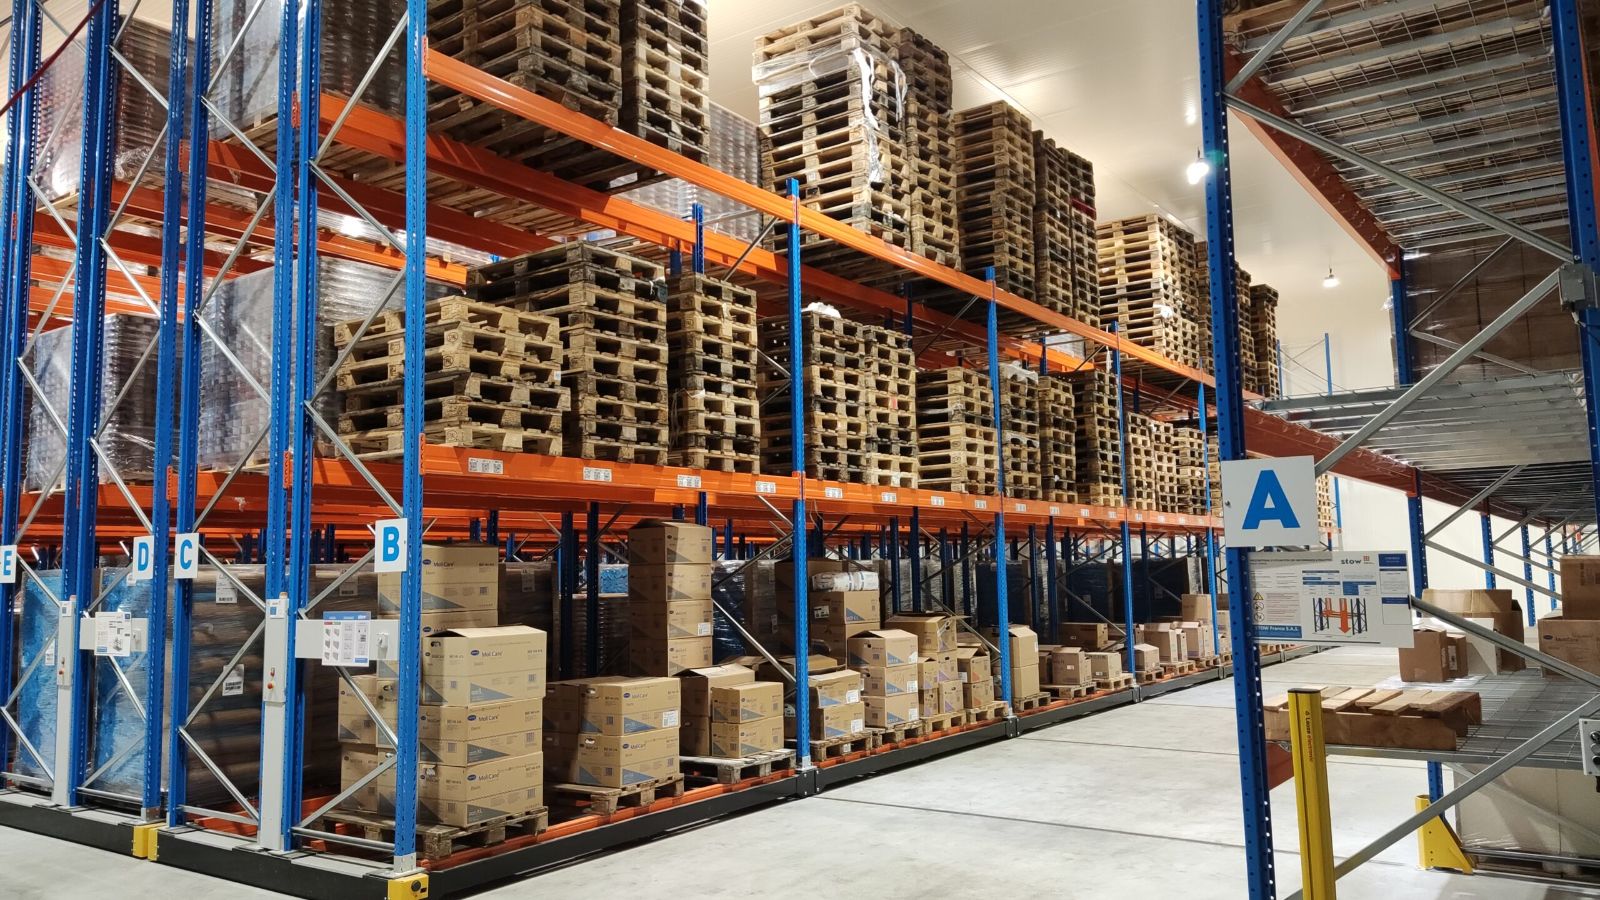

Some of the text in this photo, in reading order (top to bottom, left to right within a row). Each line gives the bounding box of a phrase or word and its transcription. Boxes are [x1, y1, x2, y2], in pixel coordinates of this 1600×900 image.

[1242, 470, 1301, 529] A
[138, 542, 149, 571] D
[180, 539, 193, 569] C
[383, 526, 400, 561] B
[3, 550, 12, 575] E
